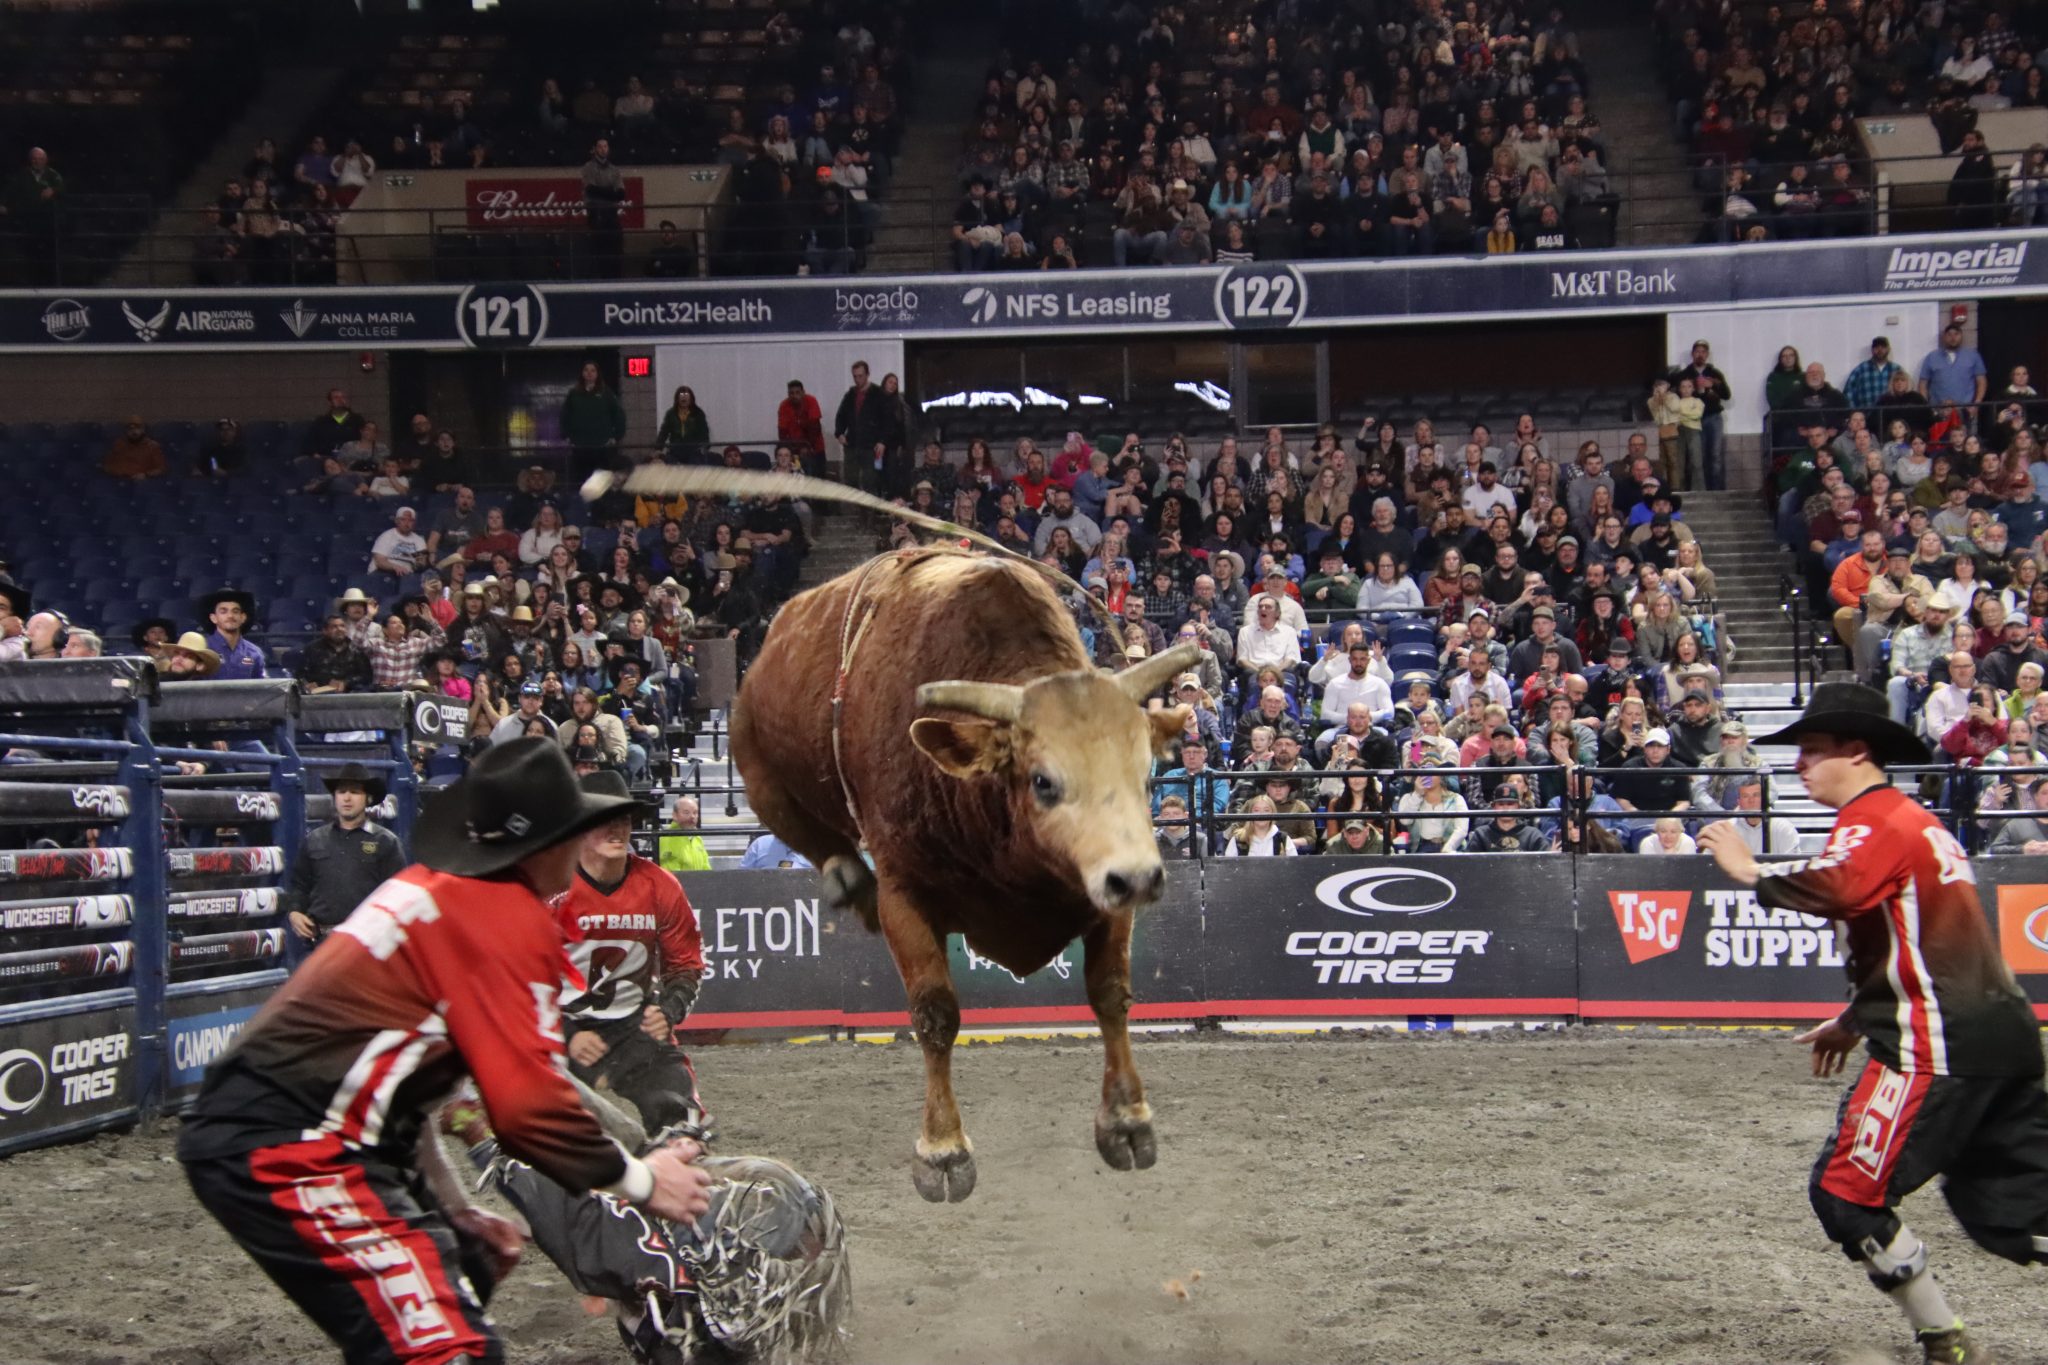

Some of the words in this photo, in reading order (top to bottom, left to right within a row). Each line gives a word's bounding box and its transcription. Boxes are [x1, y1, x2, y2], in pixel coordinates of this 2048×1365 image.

[1888, 241, 2028, 277] Imperial
[1552, 271, 1611, 296] M&T
[1617, 268, 1676, 293] Bank
[1884, 280, 1903, 289] The
[1906, 278, 1976, 288] Performance
[1977, 276, 2018, 285] Leader
[836, 286, 918, 311] bocado
[1006, 294, 1059, 318] NFS
[1067, 292, 1171, 318] Leasing
[1228, 275, 1294, 317] 122
[176, 312, 210, 331] AIR
[211, 310, 253, 319] NATIONAL
[320, 313, 363, 325] ANNA
[368, 311, 415, 324] MARIA
[469, 297, 530, 337] 121
[604, 299, 772, 325] Point32Health
[211, 319, 255, 331] GUARD
[338, 326, 398, 336] COLLEGE
[628, 358, 650, 376] EXIT
[441, 705, 468, 721] COOPER
[446, 722, 465, 737] TIRES
[4, 905, 71, 928] WORCESTER
[168, 903, 186, 914] PBR
[186, 897, 237, 916] WORCESTER
[578, 914, 601, 931] OT
[607, 914, 656, 930] BARN
[692, 899, 821, 956] LETON
[1617, 893, 1678, 950] TSC
[180, 944, 229, 956] MASSACHUSETTS
[1285, 930, 1489, 955] COOPER
[1706, 928, 1845, 967] SUPPL
[0, 961, 60, 976] ASSACHUSETTS
[702, 958, 763, 980] SKY
[1312, 959, 1457, 984] TIRES
[51, 1032, 128, 1074] COOPER
[62, 1067, 118, 1105] TIRES
[1853, 1068, 1906, 1168] PB
